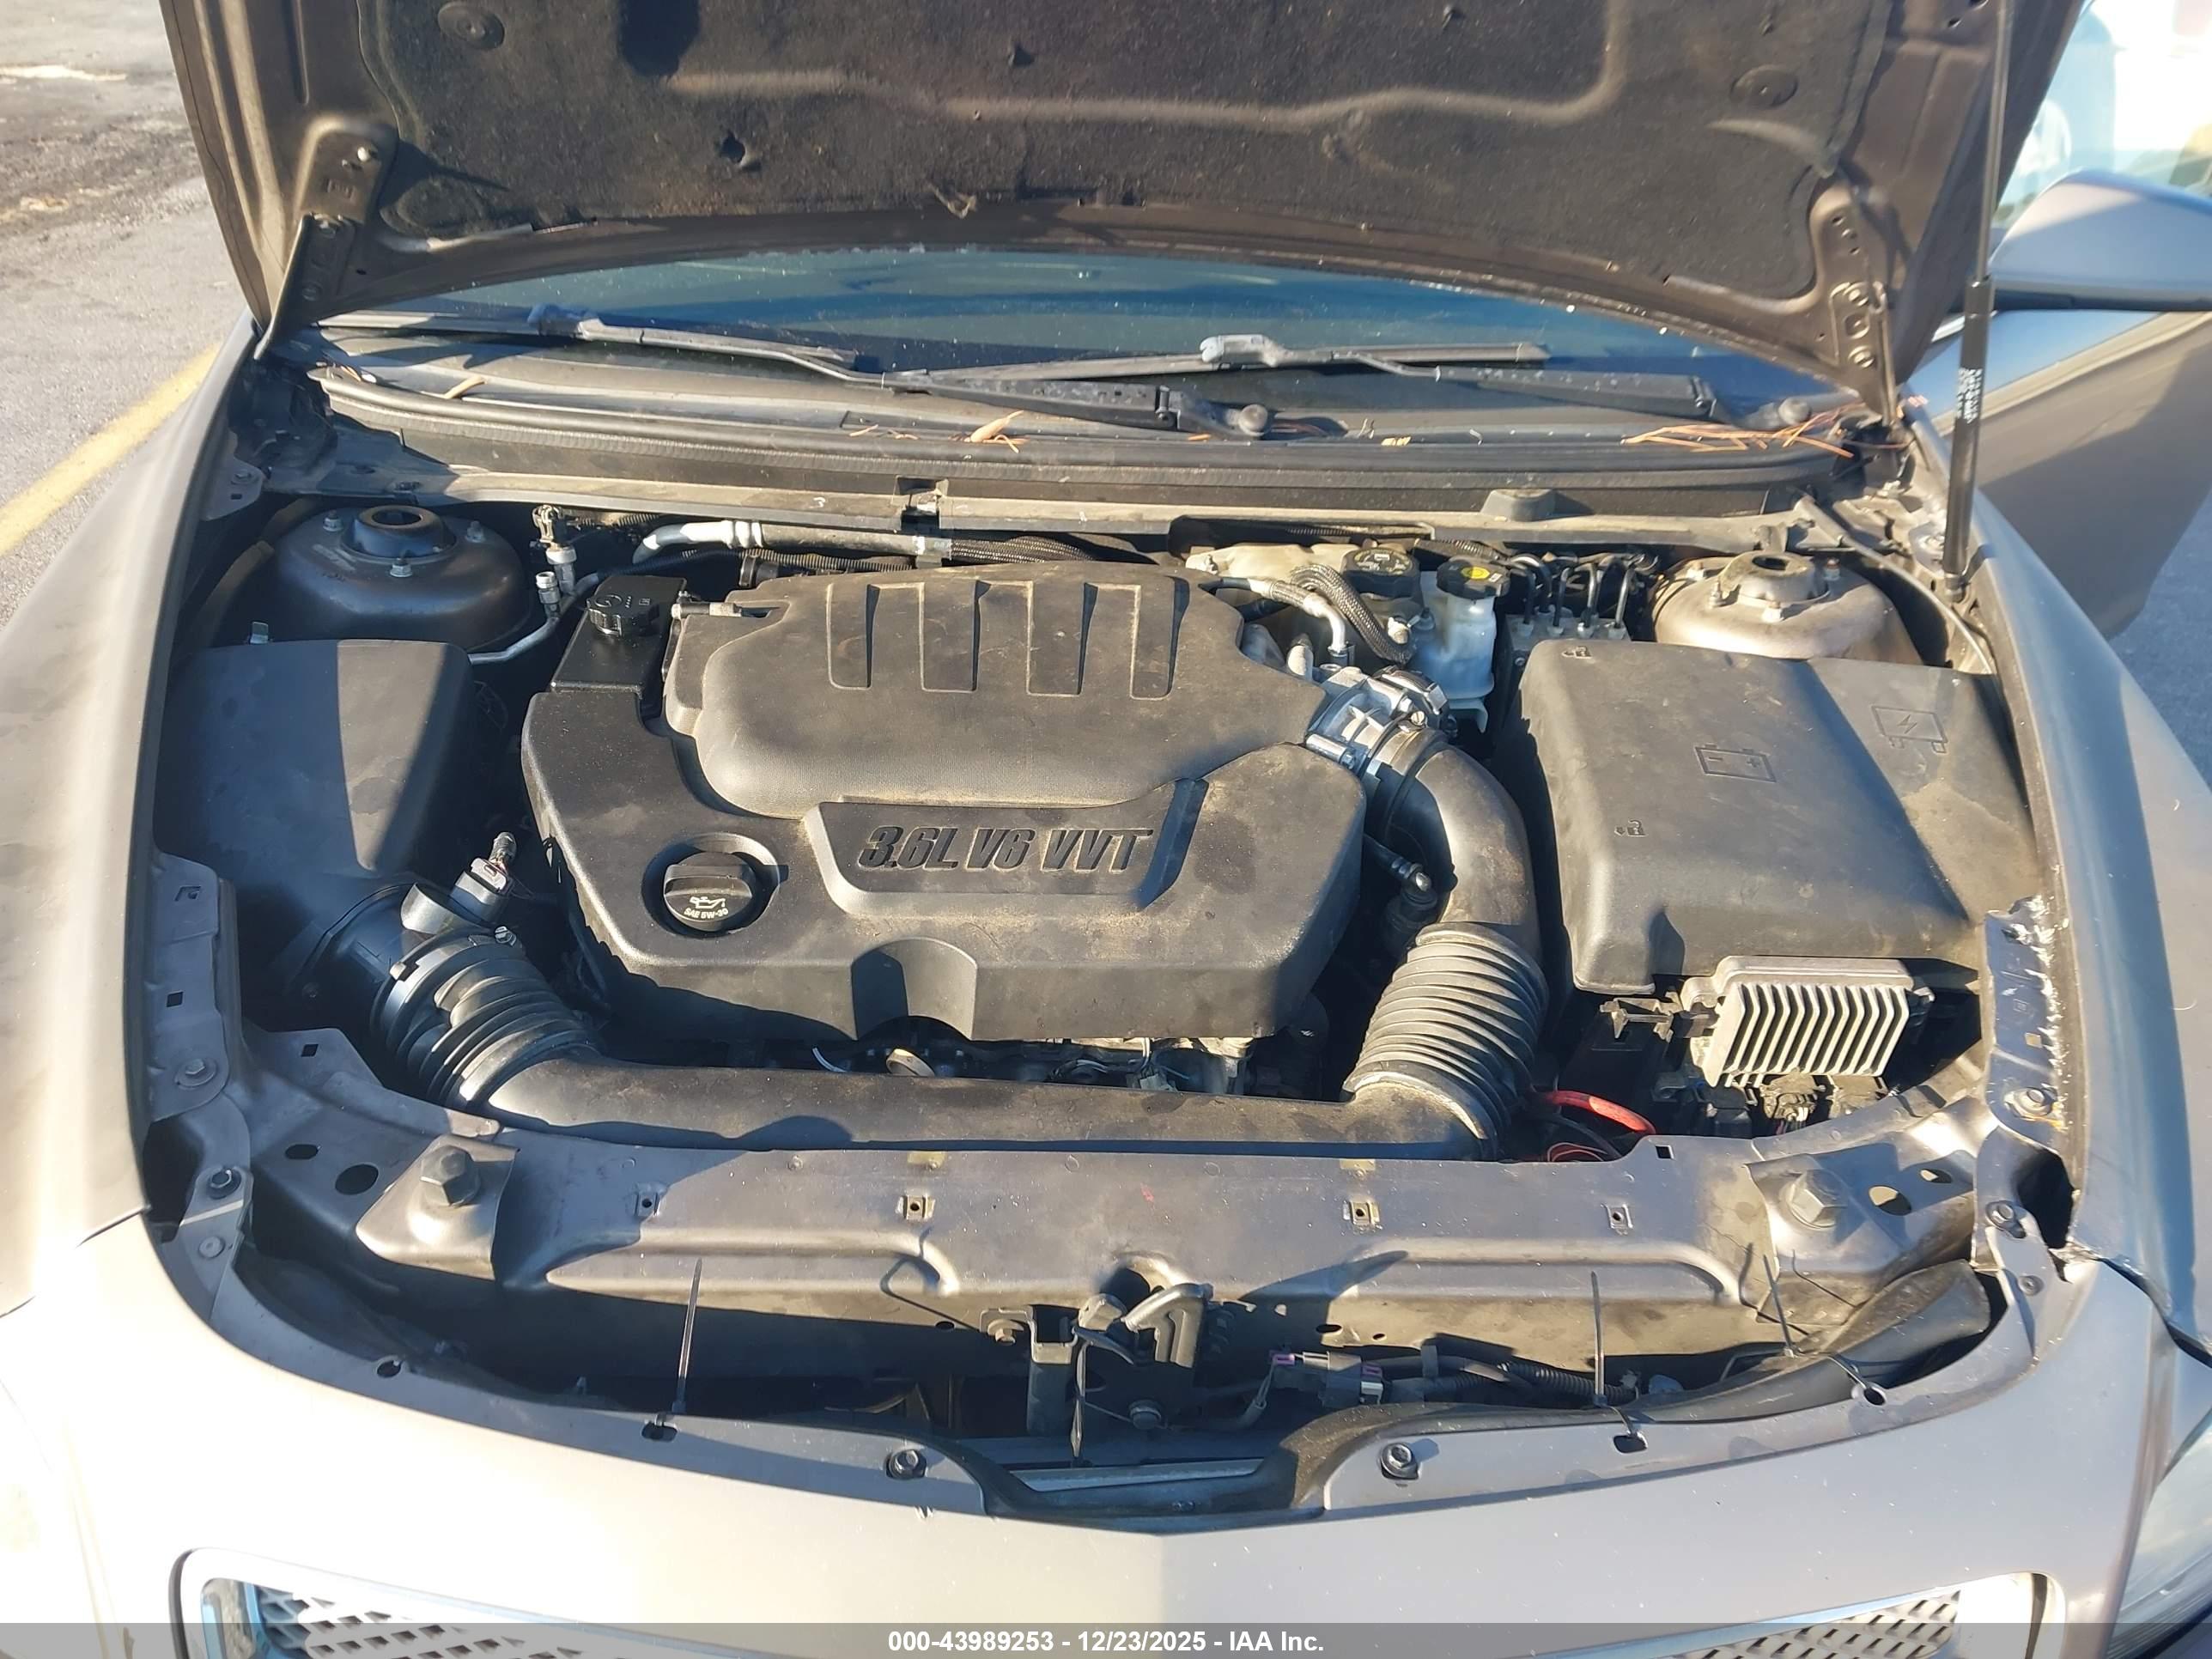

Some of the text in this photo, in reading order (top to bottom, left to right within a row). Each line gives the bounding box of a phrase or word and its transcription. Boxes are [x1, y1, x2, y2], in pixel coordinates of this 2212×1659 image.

[859, 827, 1153, 872] 3.6L V6 VVT
[684, 908, 729, 919] SAE 5W-30
